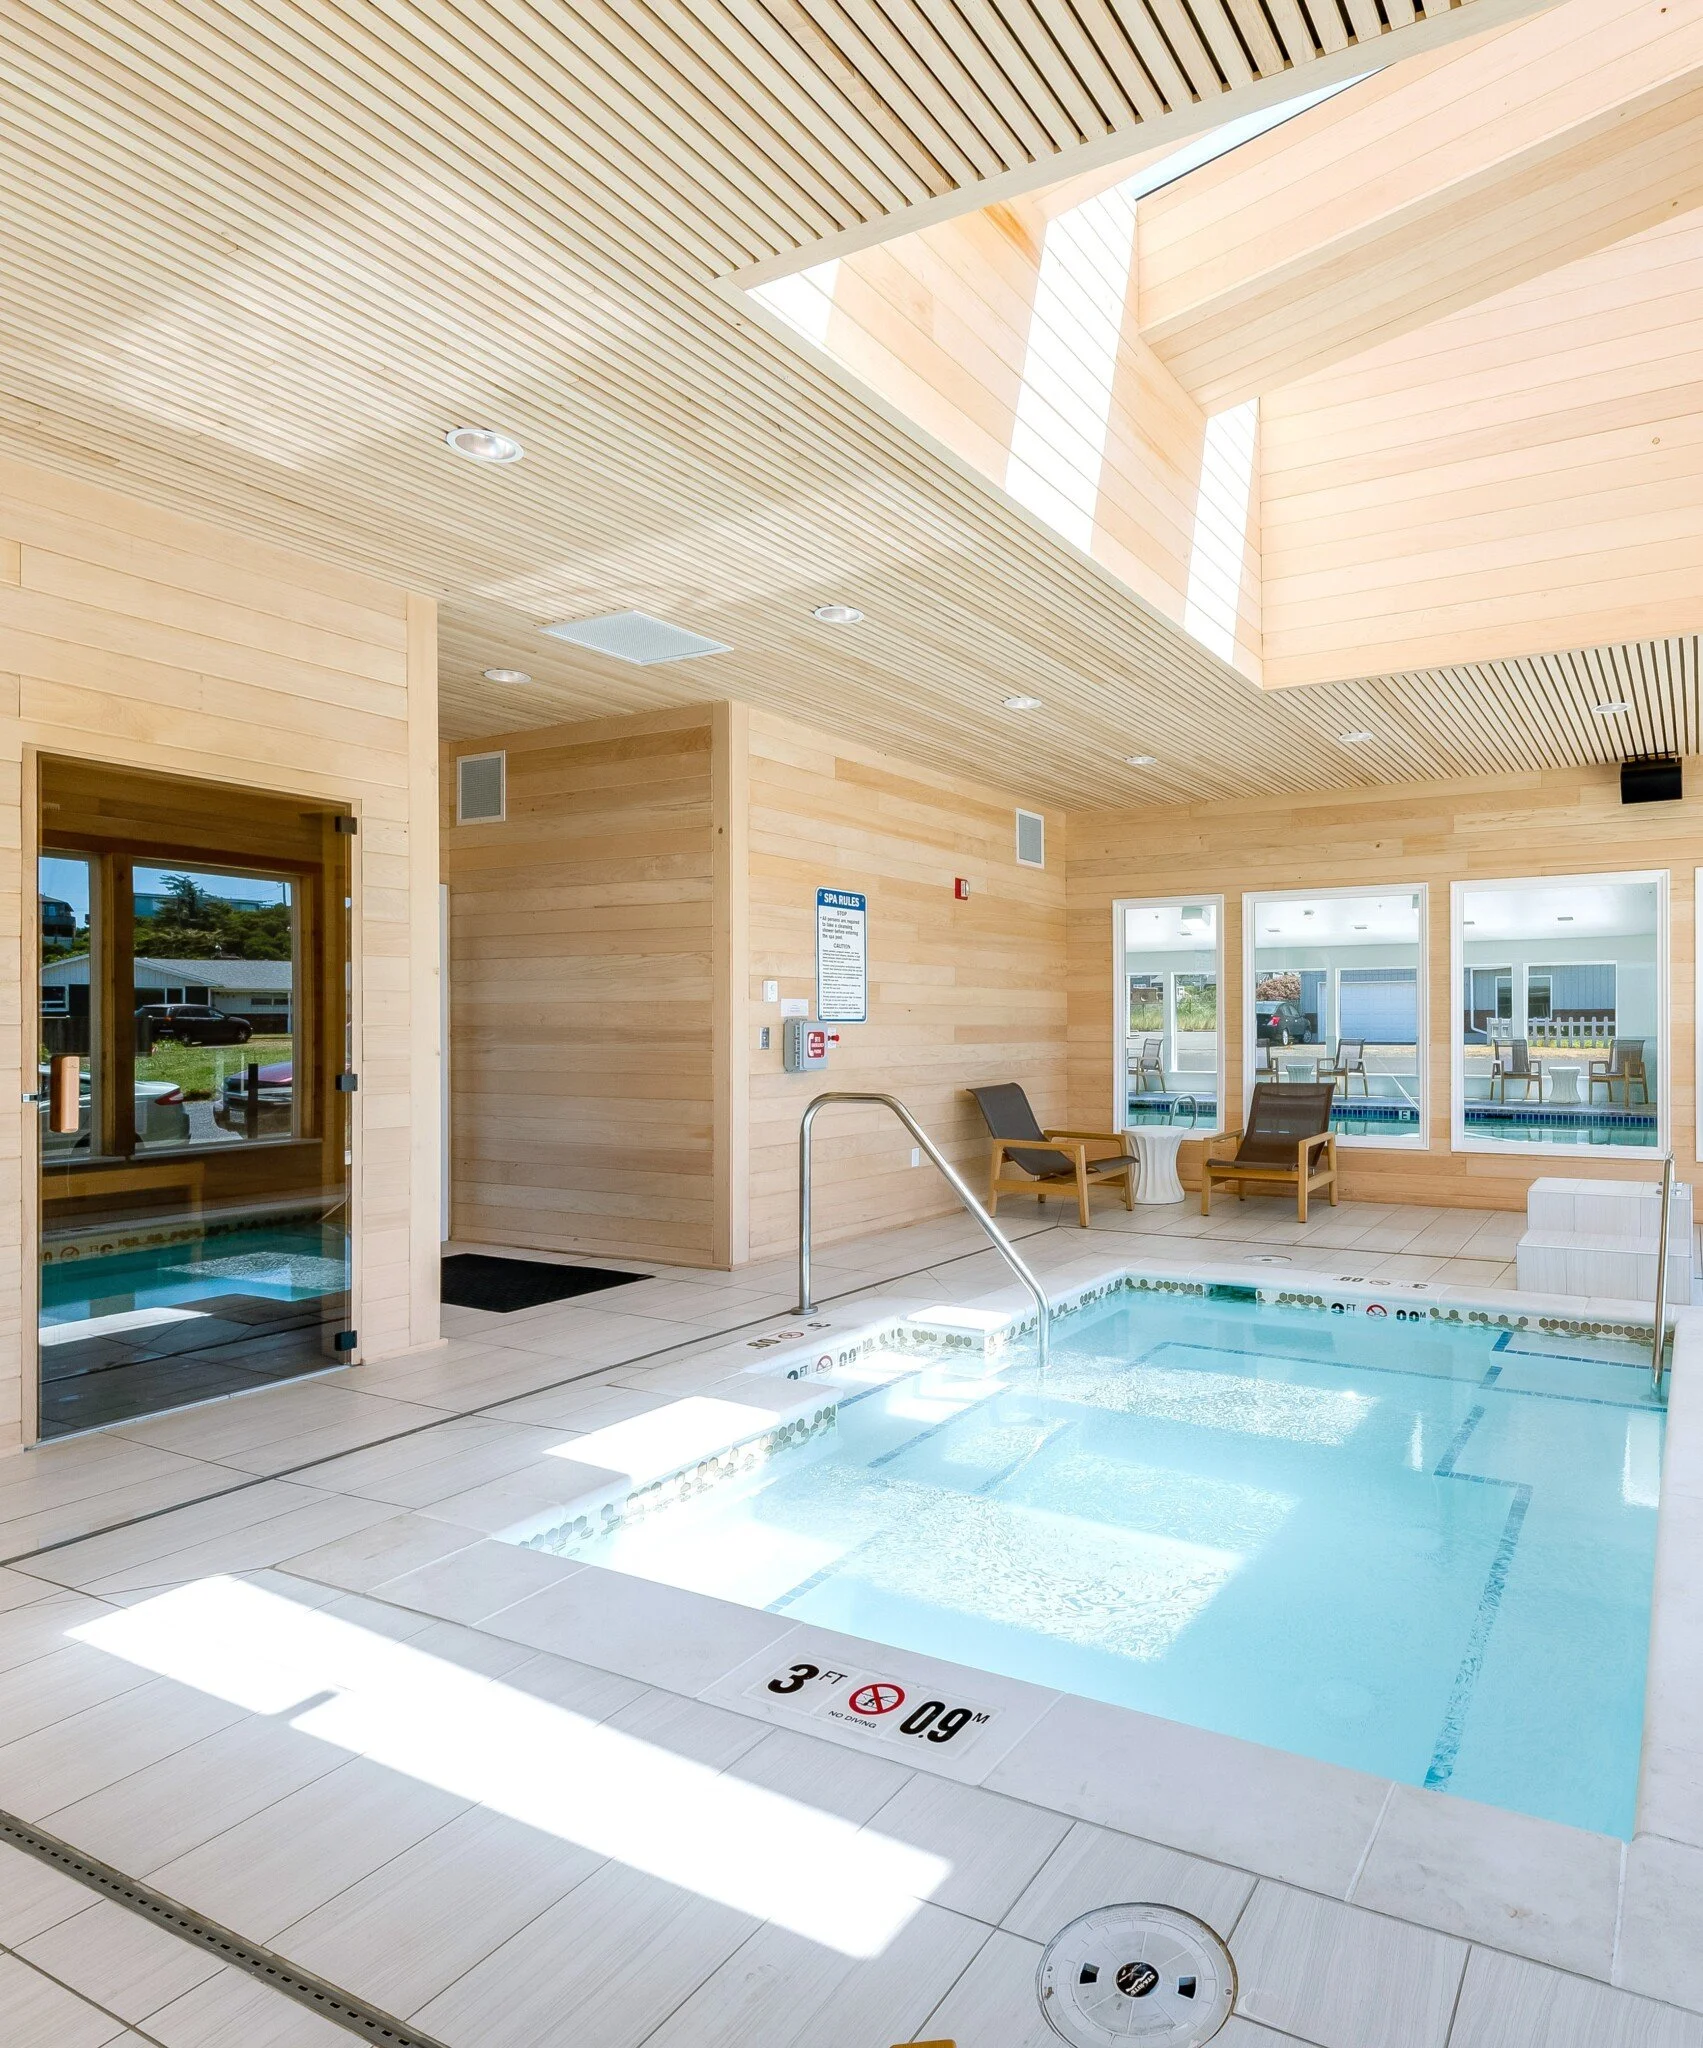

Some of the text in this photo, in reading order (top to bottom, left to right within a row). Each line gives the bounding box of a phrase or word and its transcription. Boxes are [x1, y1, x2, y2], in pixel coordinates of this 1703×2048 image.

[824, 893, 860, 907] SPA RULES
[800, 1365, 808, 1378] FT
[768, 1664, 848, 1694] 3 FT
[828, 1710, 877, 1729] NO DIVING
[900, 1701, 990, 1743] 0.9 M
